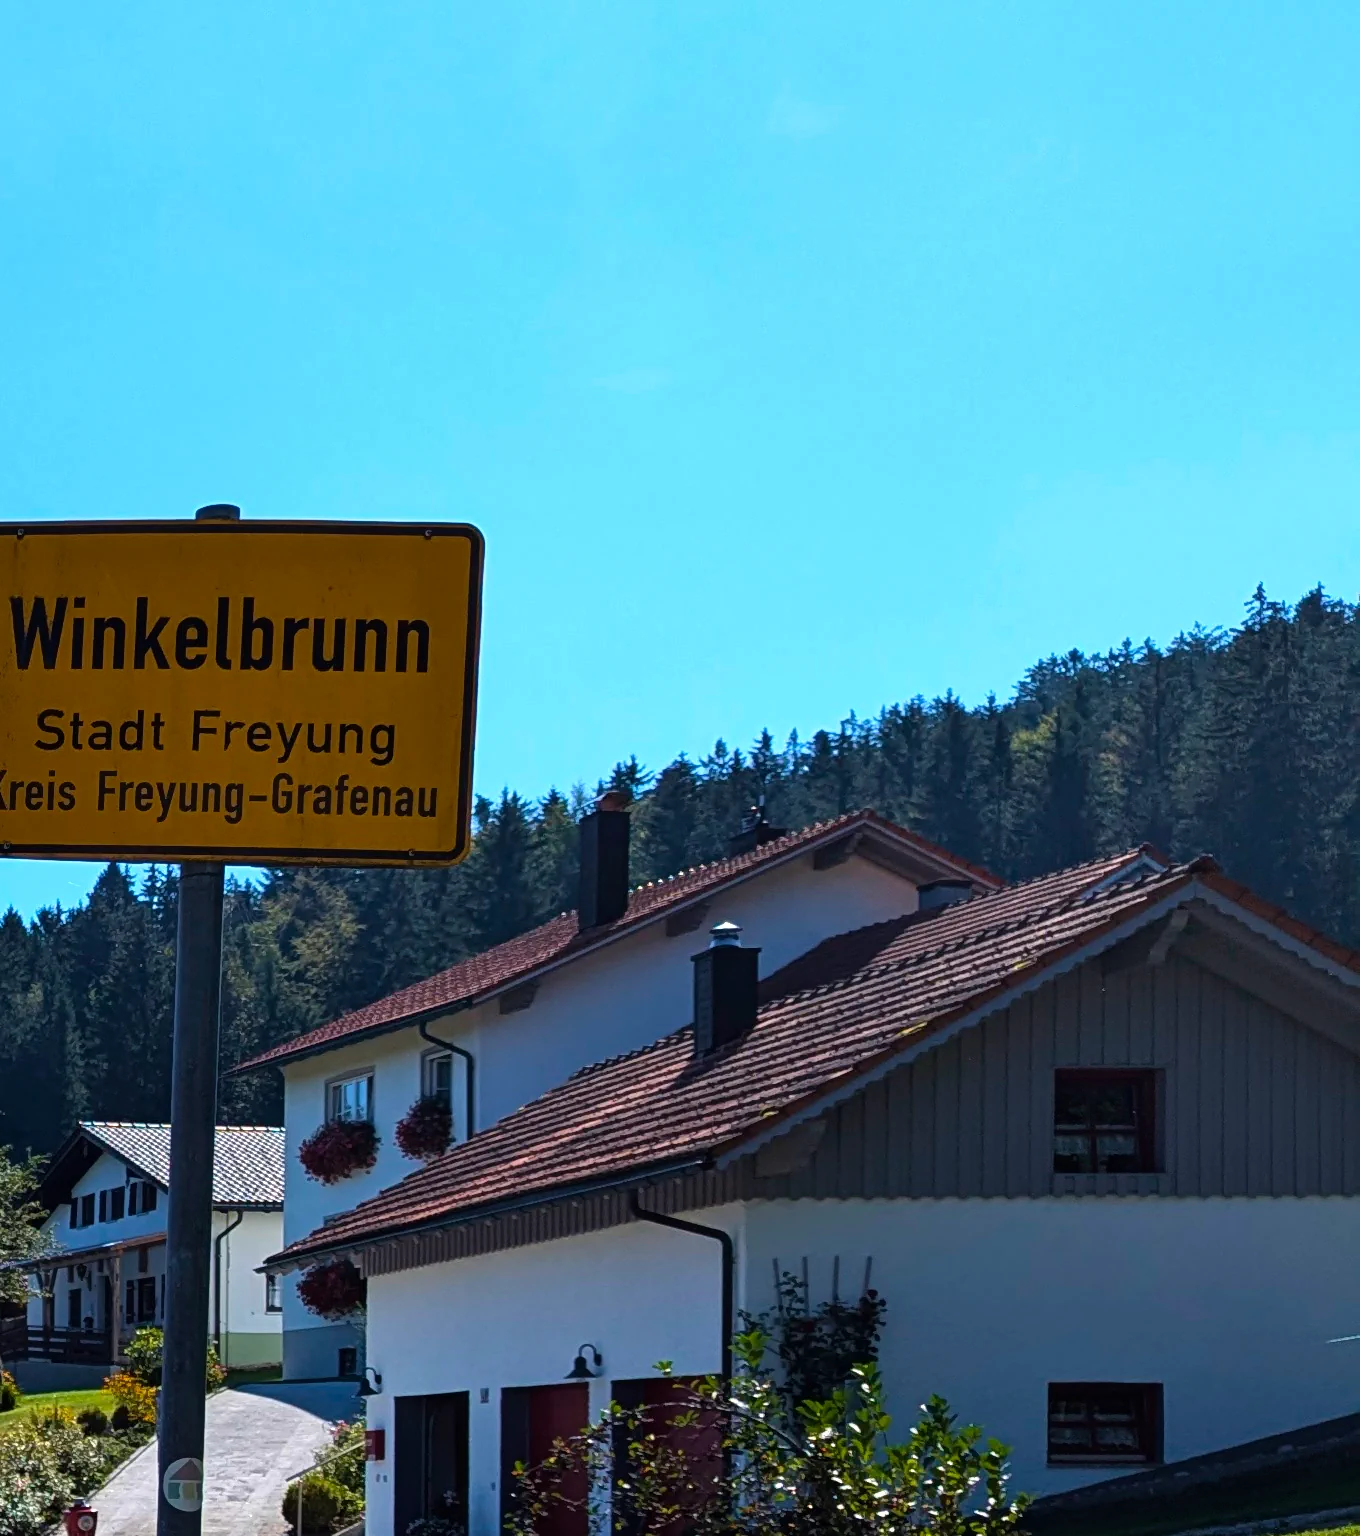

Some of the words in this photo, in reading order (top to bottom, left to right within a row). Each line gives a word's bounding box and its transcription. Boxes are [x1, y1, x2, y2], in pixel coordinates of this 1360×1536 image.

[8, 595, 431, 674] Winkelbrunn
[34, 708, 166, 752] Stadt
[191, 709, 396, 766] Freyung
[96, 769, 439, 825] Freyung-Grafenau
